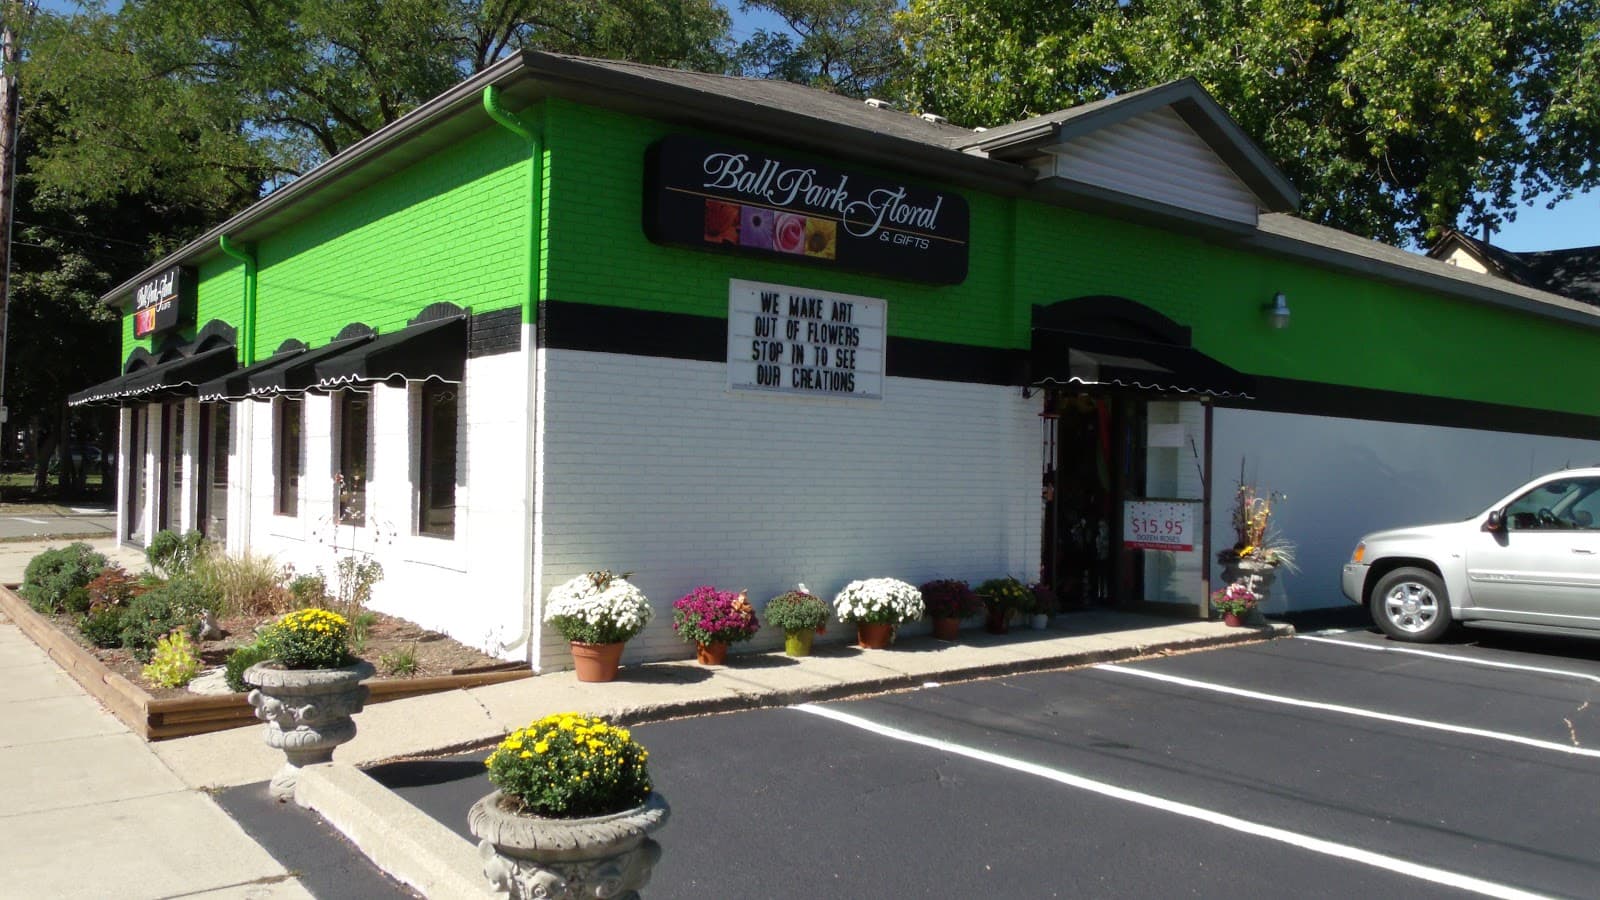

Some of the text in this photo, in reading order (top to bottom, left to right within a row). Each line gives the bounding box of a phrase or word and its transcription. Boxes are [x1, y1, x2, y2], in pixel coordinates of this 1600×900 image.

[703, 153, 943, 237] Ball Park Floral
[879, 231, 930, 250] & GIFTS
[760, 291, 853, 323] WE MAKE ART
[755, 316, 860, 347] OUT OF FLOWERS
[752, 340, 856, 369] STOP IN TO SEE
[757, 364, 855, 392] OUR CREATIONS
[1132, 518, 1183, 535] $15.95
